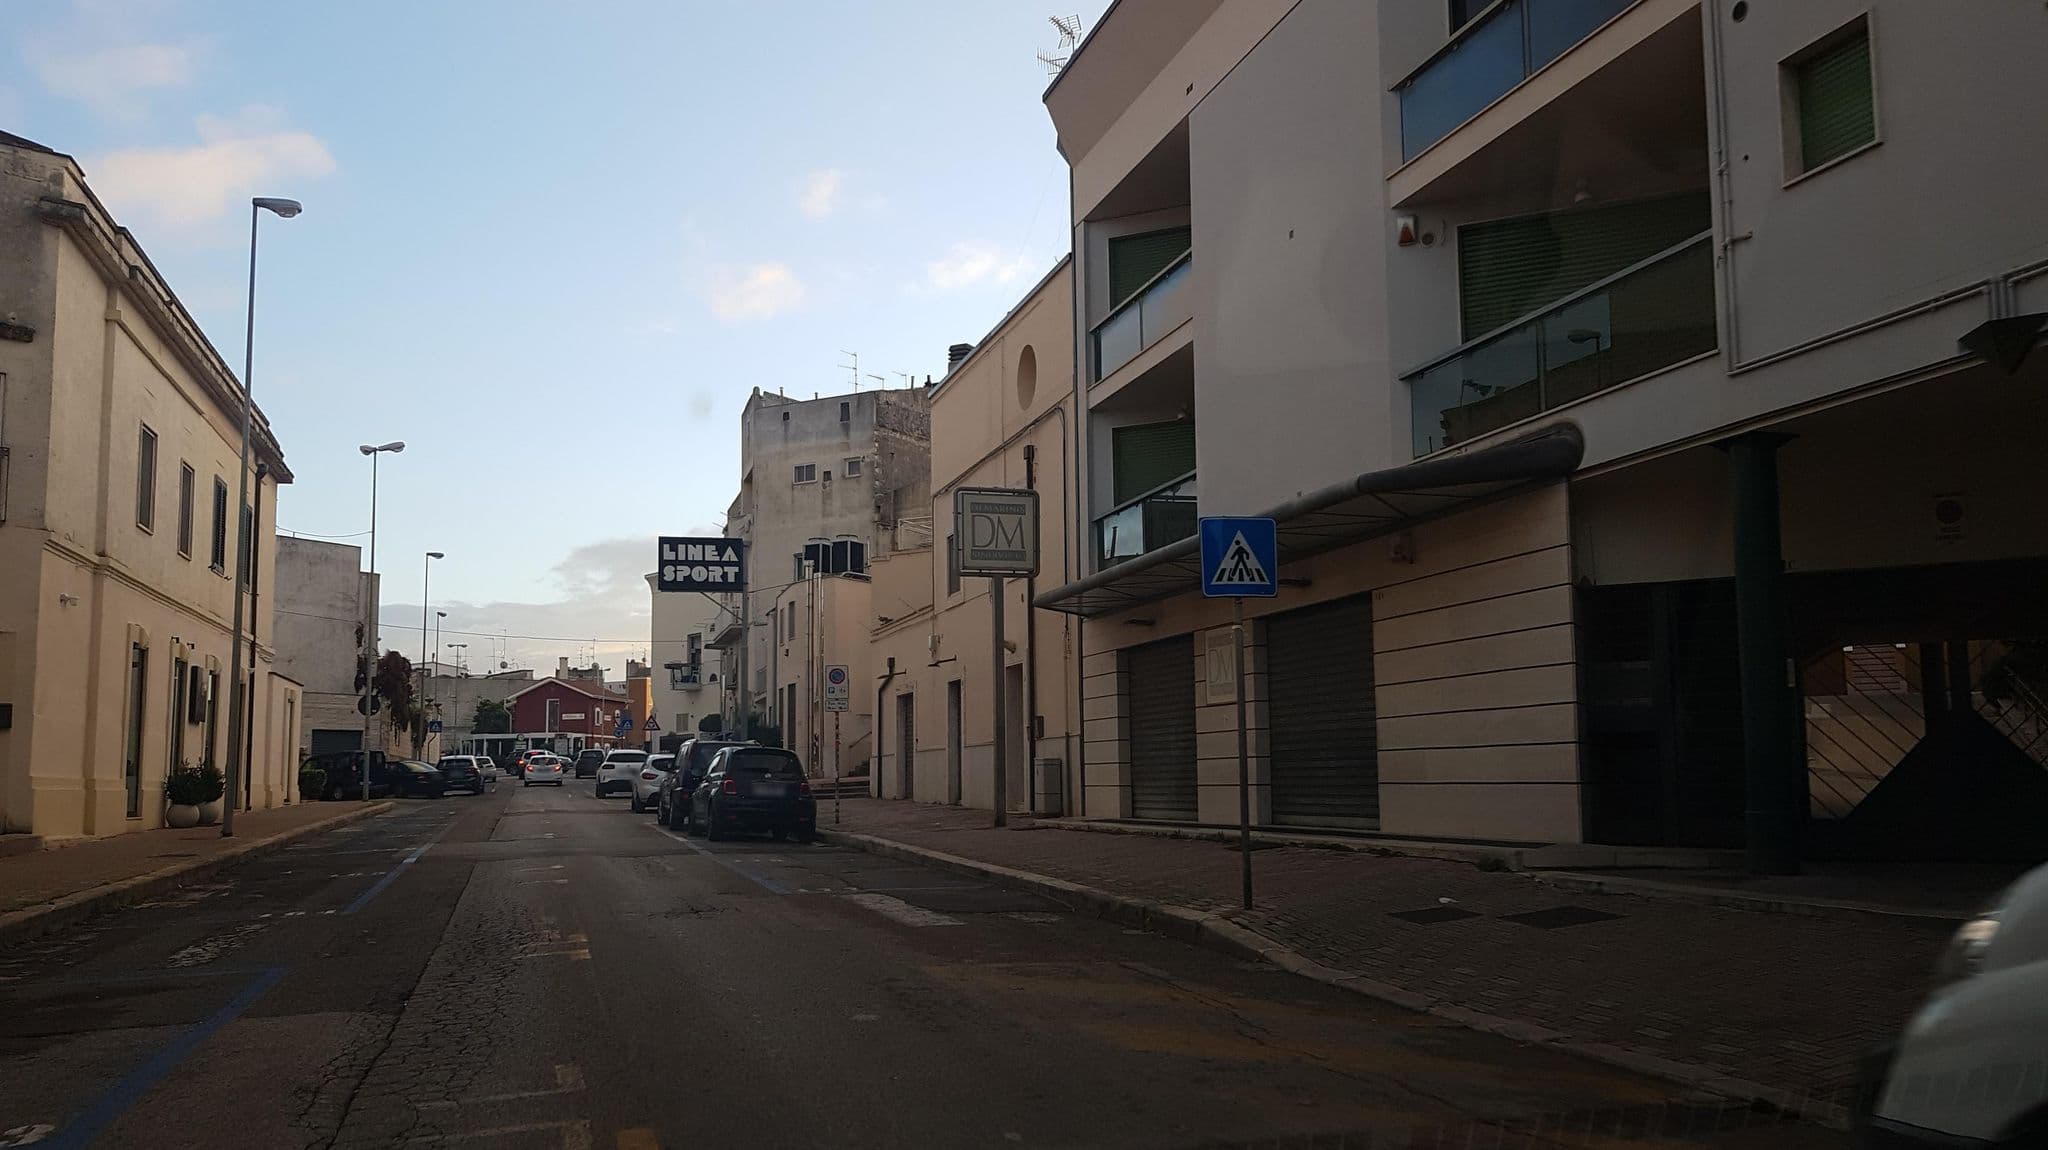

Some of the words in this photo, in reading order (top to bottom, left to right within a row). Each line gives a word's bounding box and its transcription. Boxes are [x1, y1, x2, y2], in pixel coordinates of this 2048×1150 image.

[971, 514, 1026, 549] DM
[663, 544, 739, 562] LINEA
[663, 565, 739, 583] SPORT
[1208, 645, 1235, 684] DM
